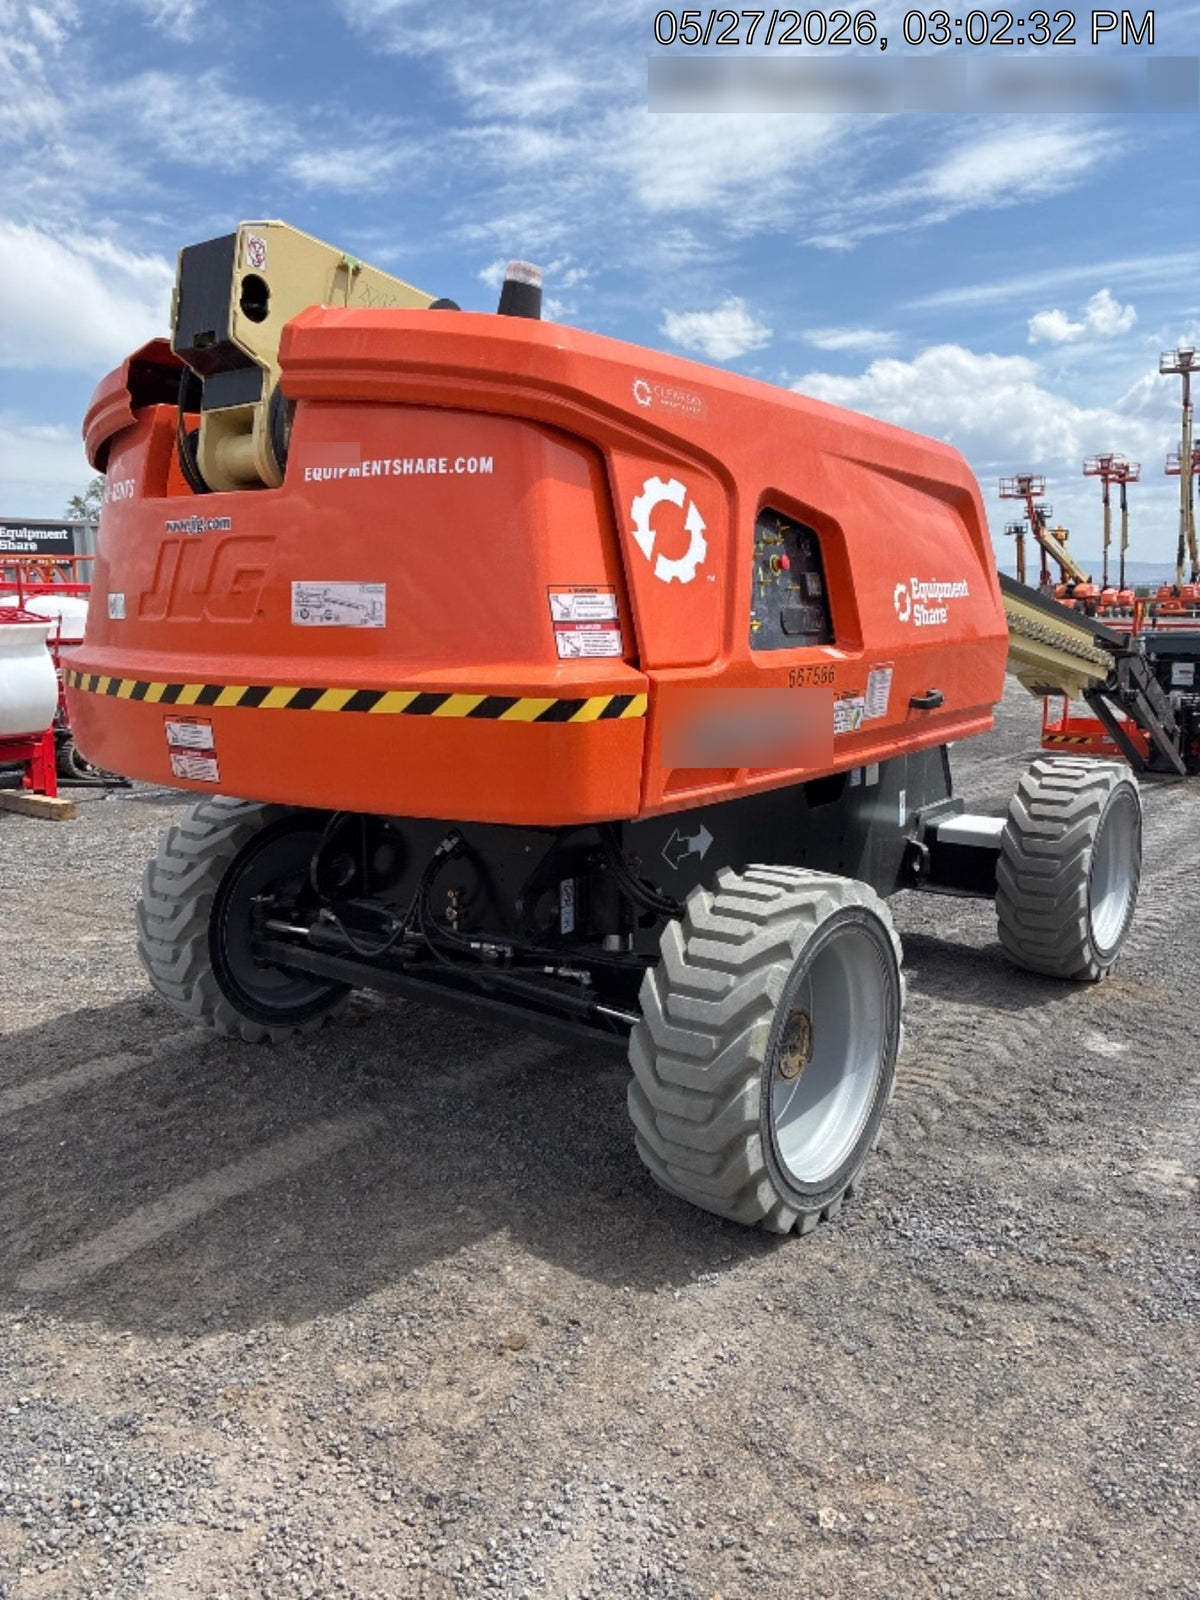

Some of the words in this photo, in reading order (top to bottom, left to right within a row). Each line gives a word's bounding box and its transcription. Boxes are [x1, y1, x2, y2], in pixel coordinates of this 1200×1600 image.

[0, 526, 68, 541] Equipment
[165, 515, 233, 534] www.jlg.com
[0, 540, 38, 552] Share
[138, 535, 276, 624] JLG
[910, 577, 969, 603] Equipment
[913, 603, 948, 627] Share
